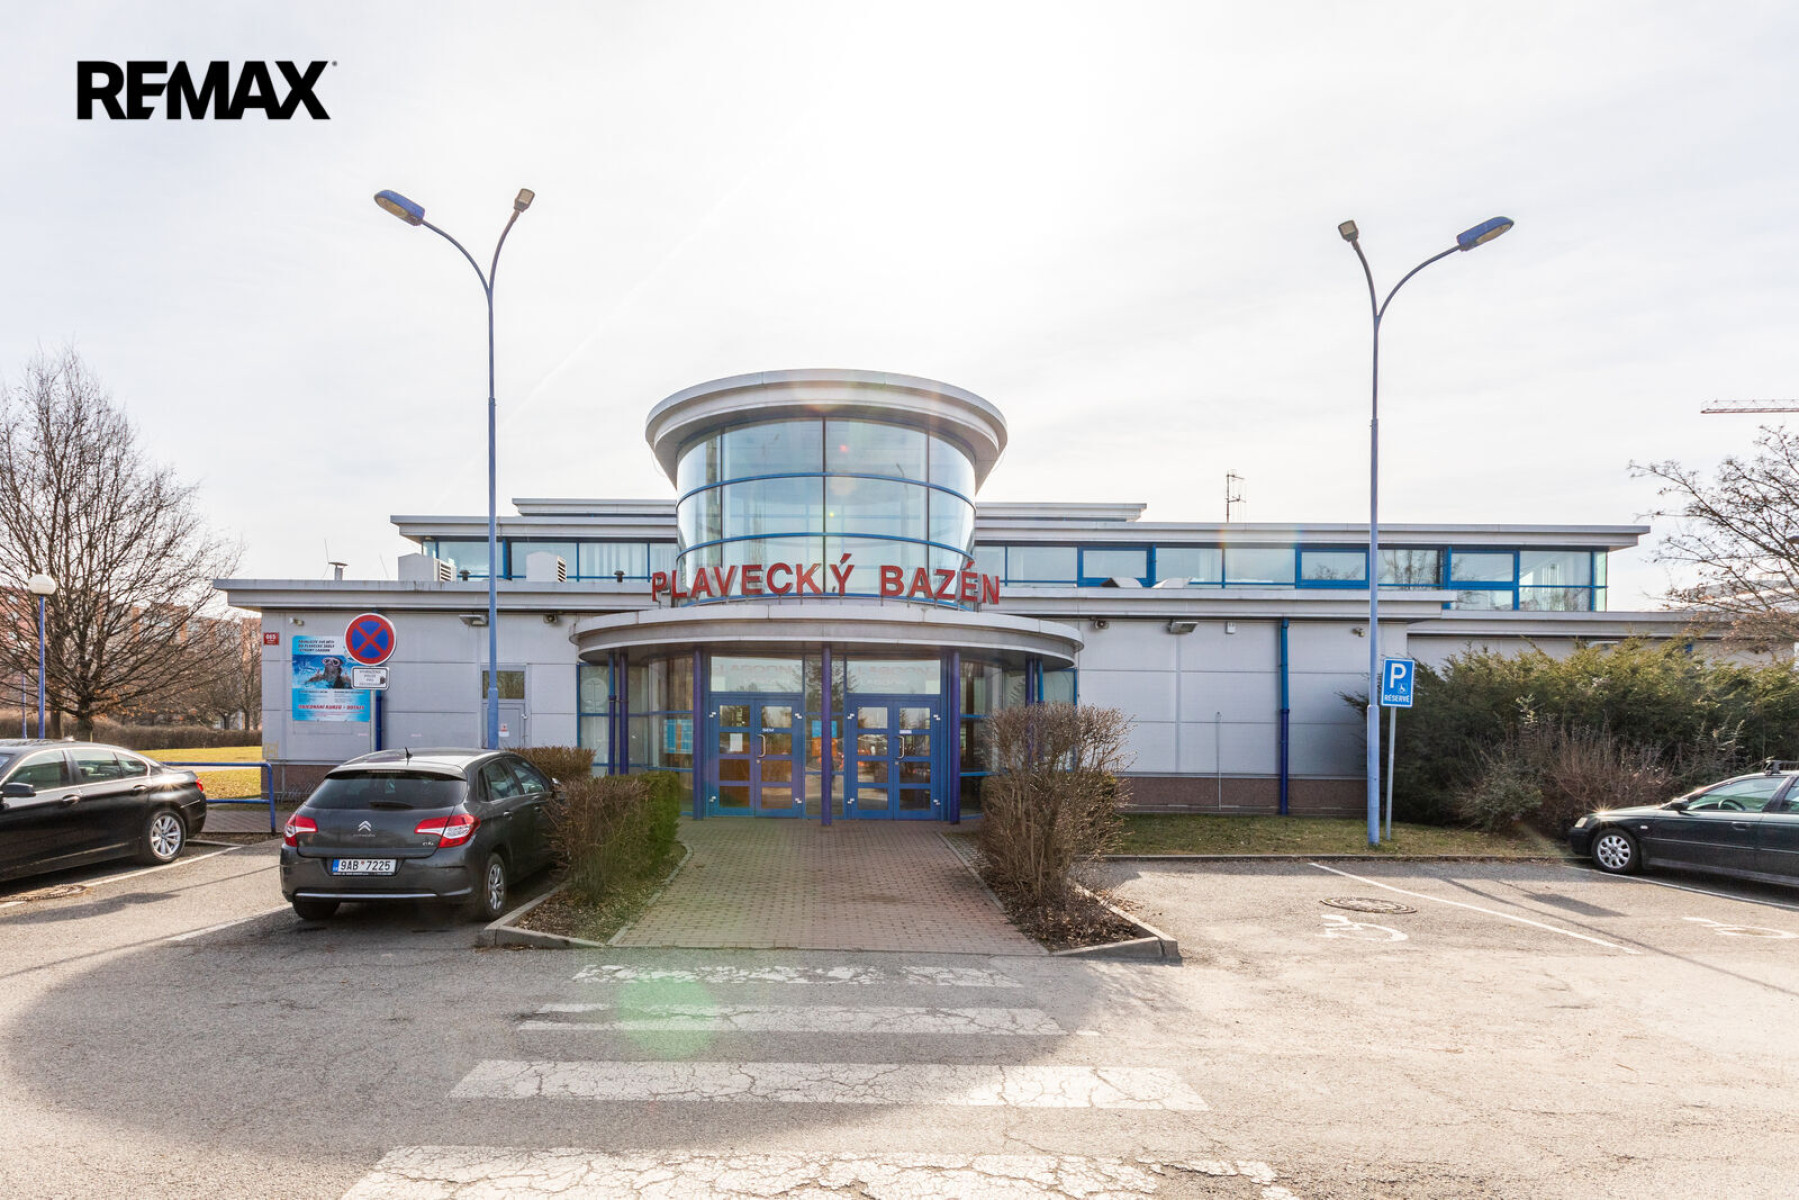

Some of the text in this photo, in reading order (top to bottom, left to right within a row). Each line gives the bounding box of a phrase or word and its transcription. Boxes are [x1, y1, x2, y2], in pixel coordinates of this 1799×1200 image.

[651, 552, 1000, 604] PLAVECKÝ BAZÉN
[1390, 663, 1407, 689] P
[340, 860, 359, 871] 9AB
[366, 860, 391, 871] 7225
